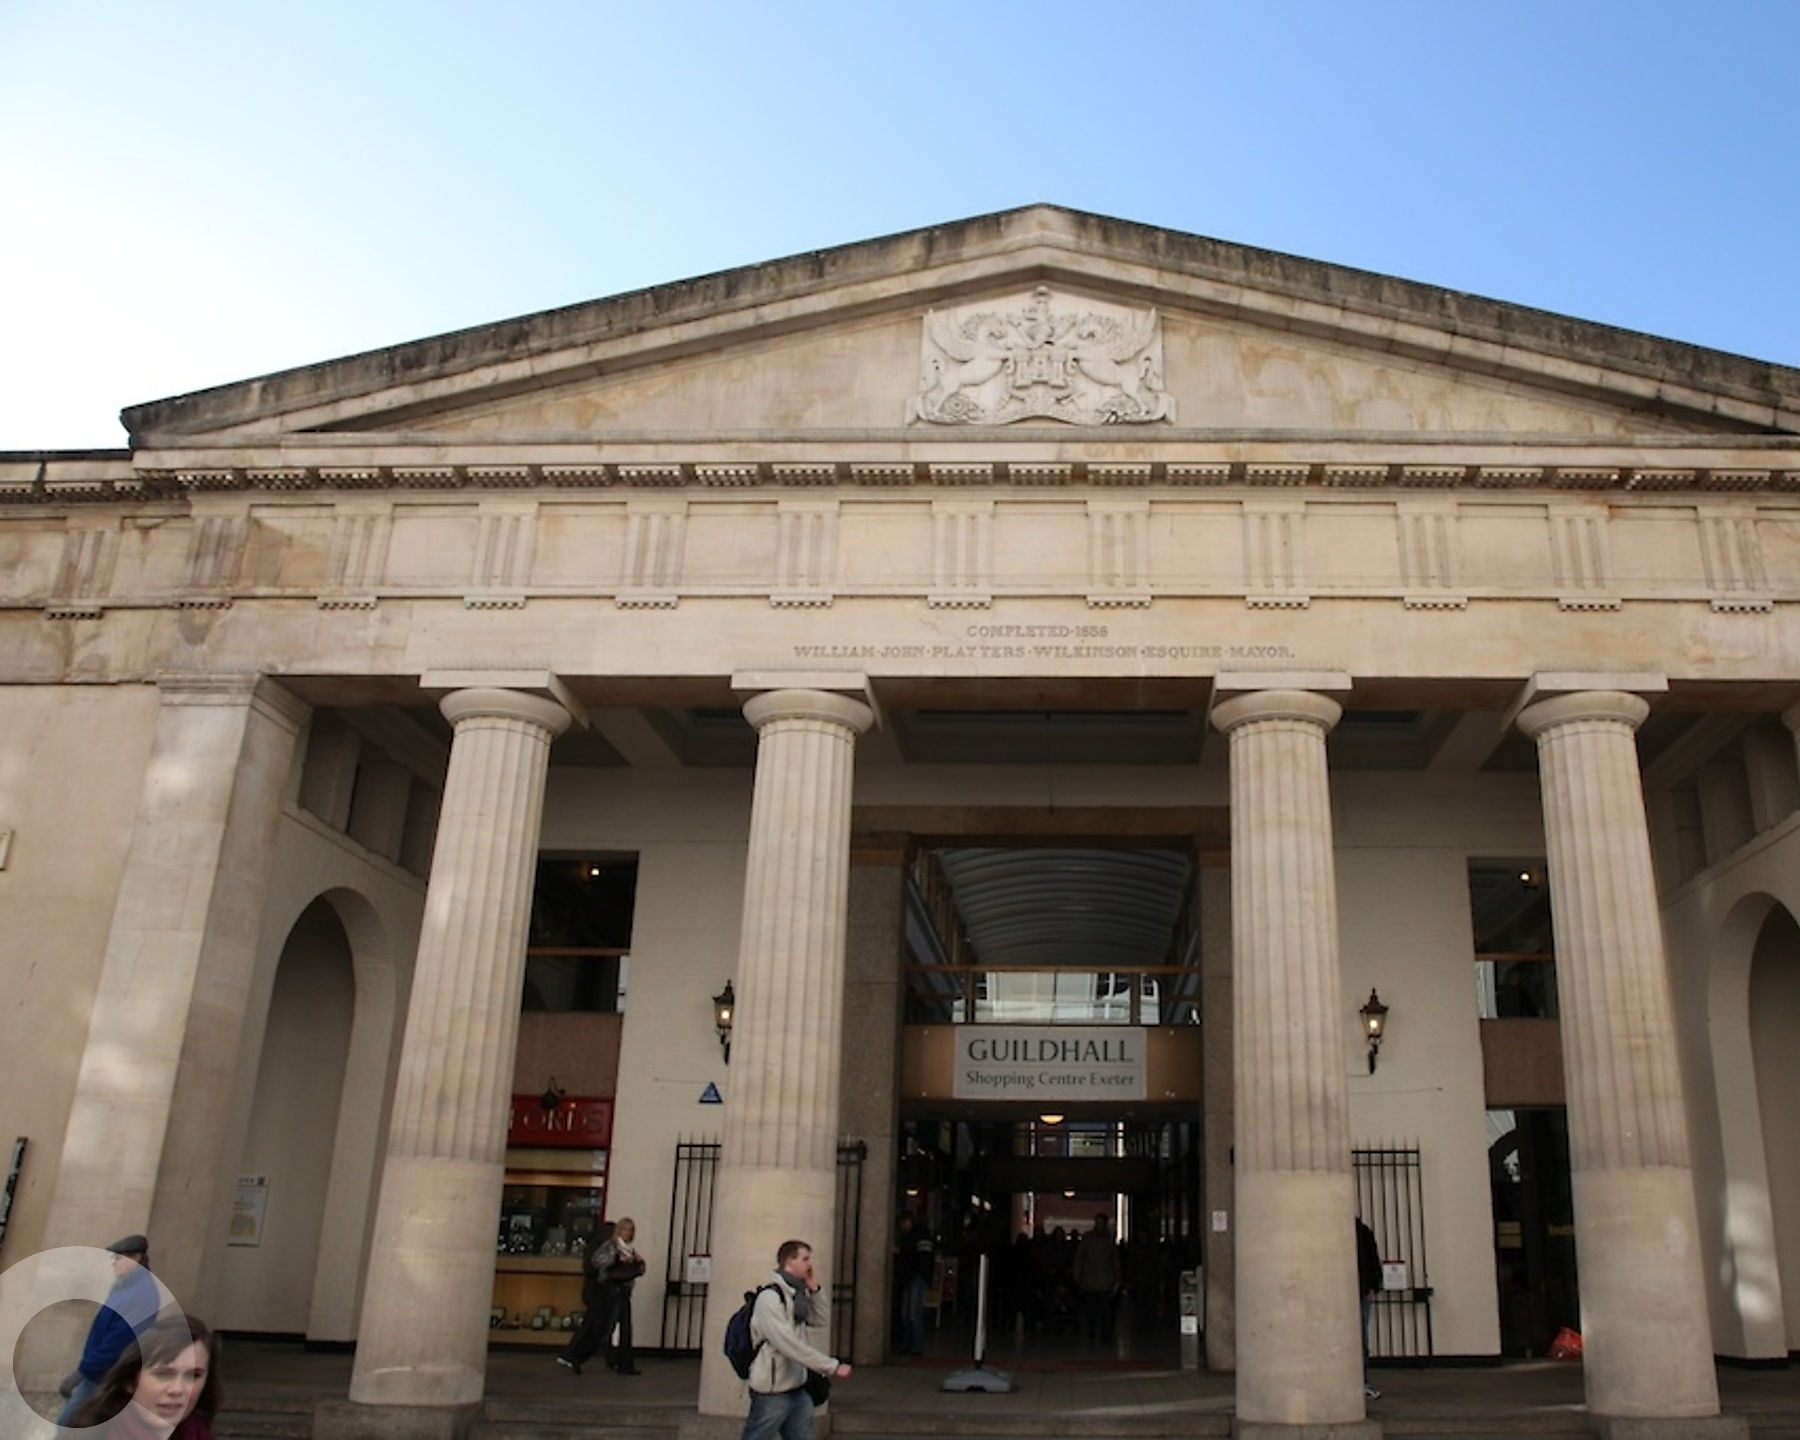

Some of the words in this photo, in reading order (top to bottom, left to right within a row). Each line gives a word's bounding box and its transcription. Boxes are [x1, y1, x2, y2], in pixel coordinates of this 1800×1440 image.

[966, 625, 1069, 638] COMPLETED
[793, 646, 875, 658] WILLIAM
[880, 646, 925, 658] JOHN
[1032, 646, 1138, 658] WILKINSON
[1145, 646, 1222, 660] ESQUIRE
[968, 1039, 1135, 1062] GUILDHALL
[966, 1071, 1034, 1088] Shopping
[1038, 1071, 1087, 1086] Centre
[1090, 1072, 1135, 1086] Exeter
